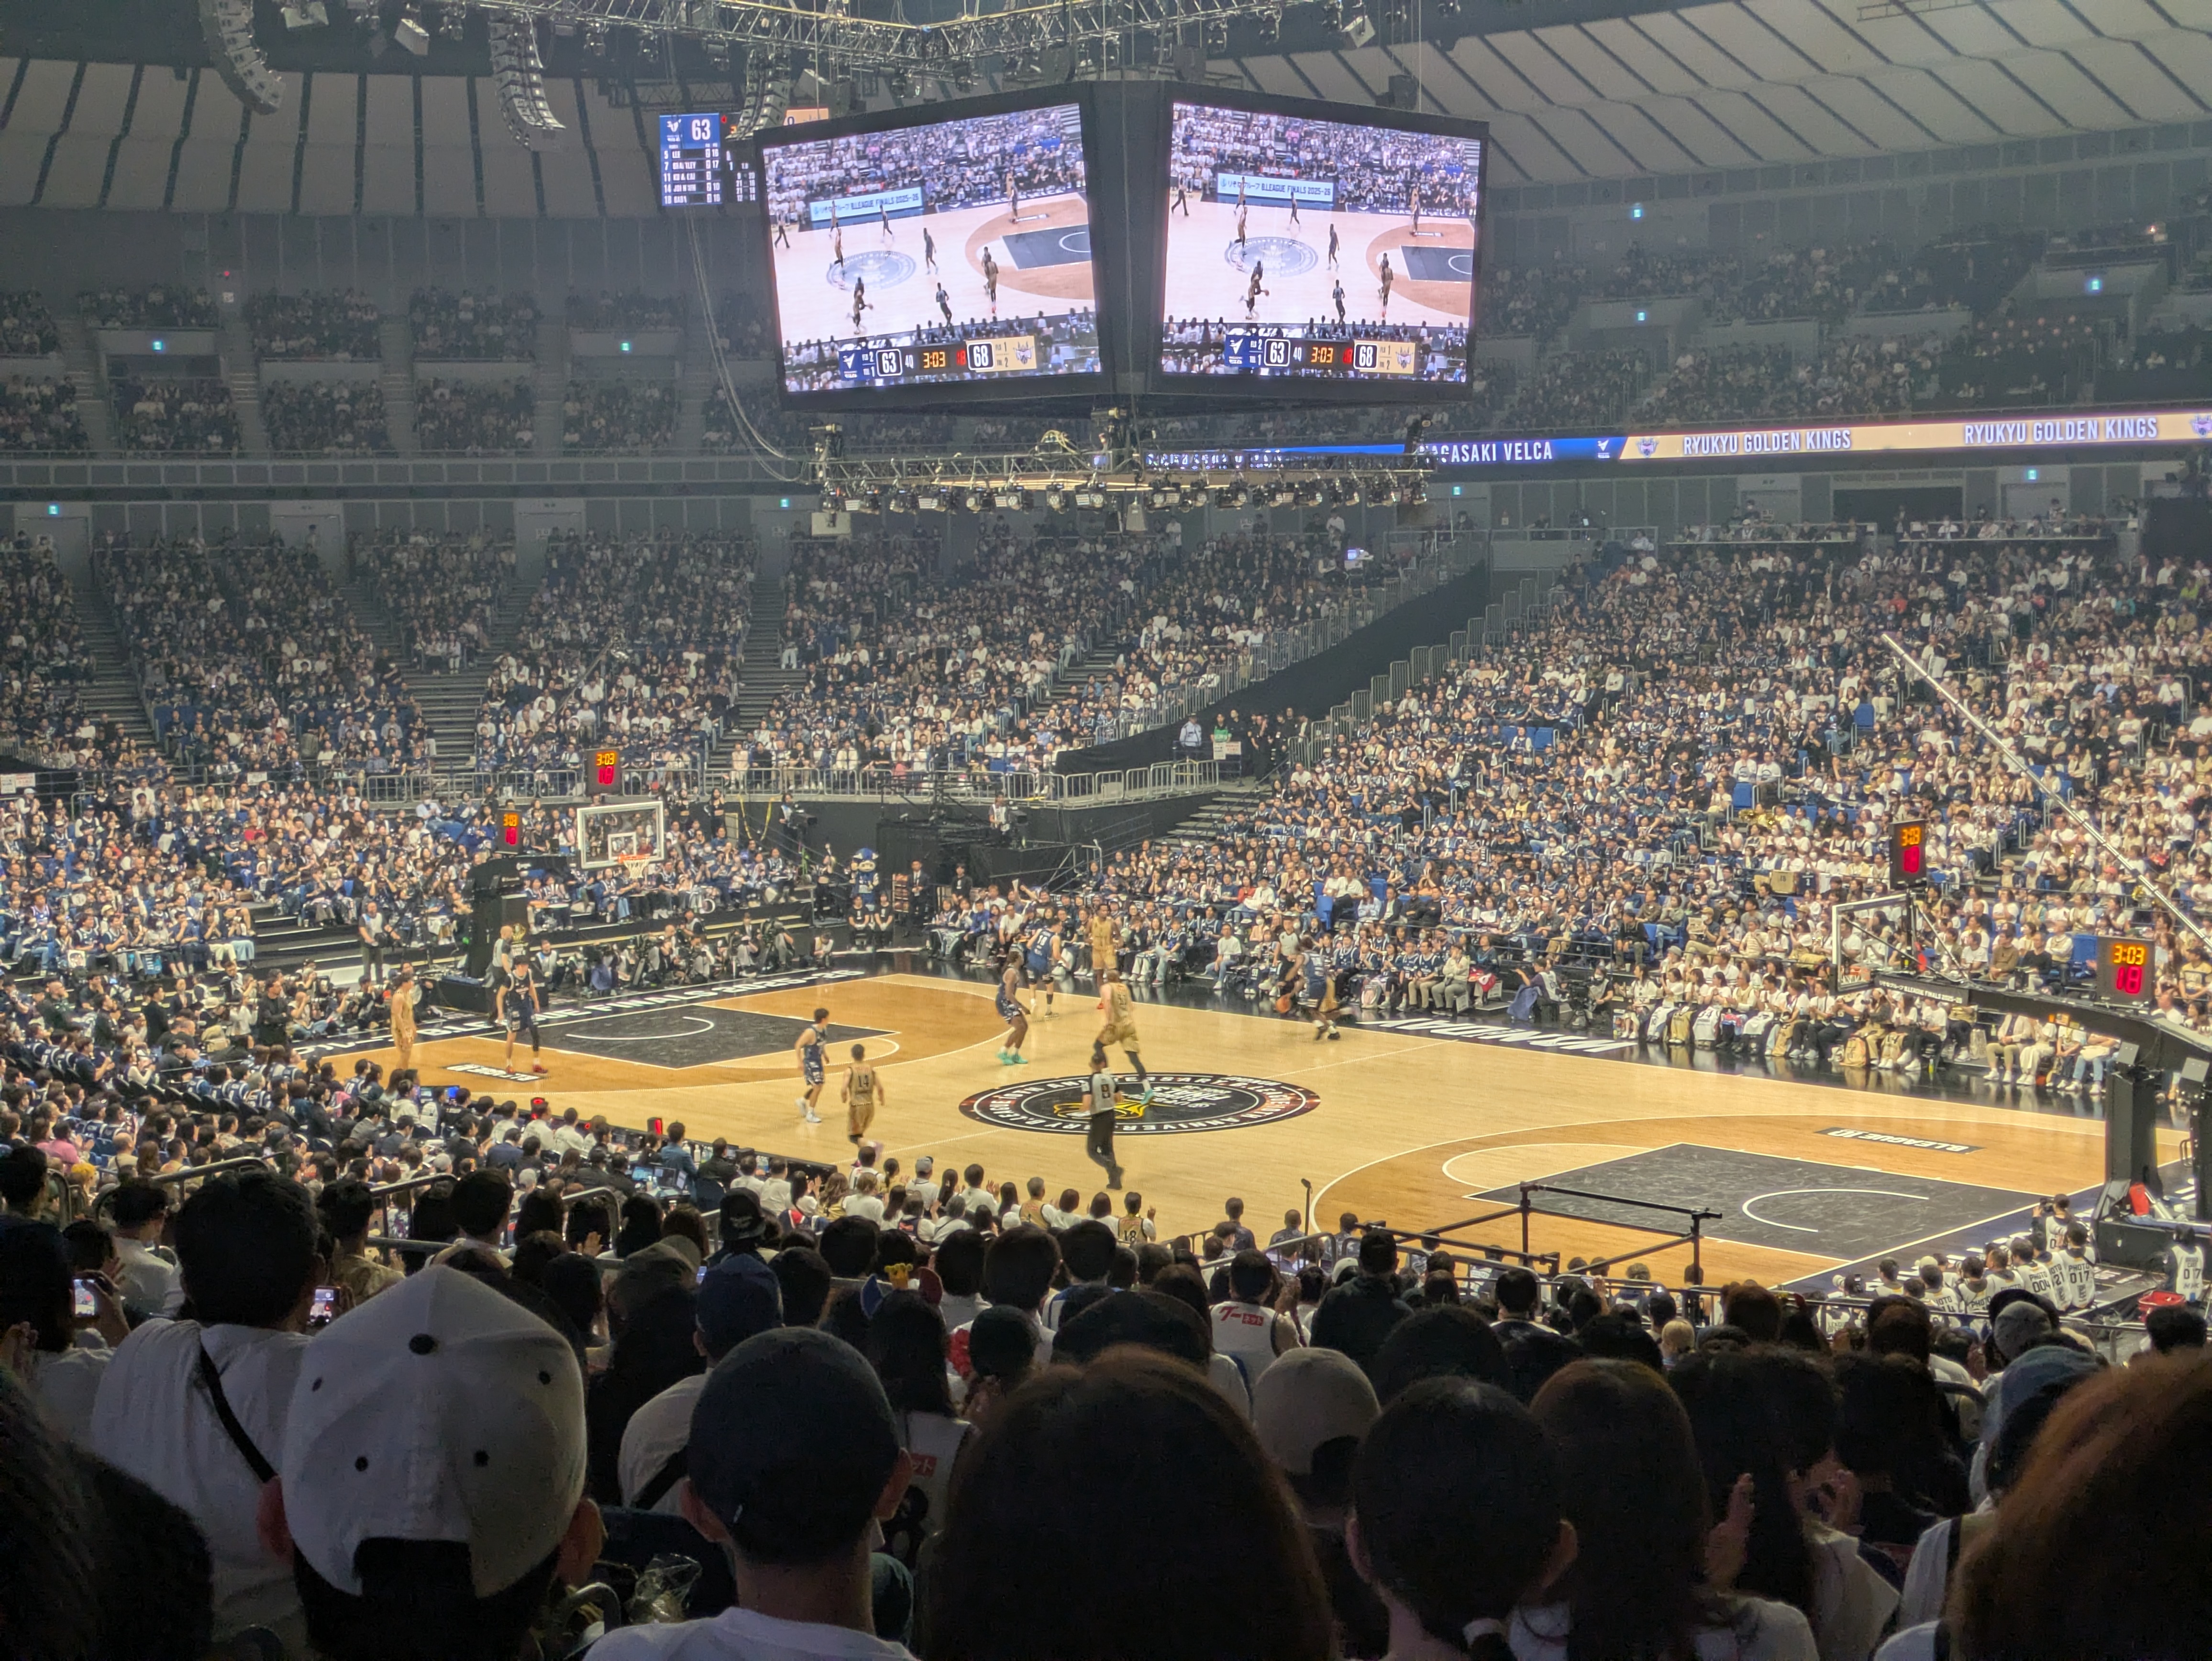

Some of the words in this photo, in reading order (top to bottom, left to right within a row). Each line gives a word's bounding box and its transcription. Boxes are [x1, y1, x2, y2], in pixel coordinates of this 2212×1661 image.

[692, 119, 710, 140] 63
[664, 162, 669, 170] 7
[713, 160, 719, 168] 17
[664, 173, 670, 182] 11
[664, 184, 671, 193] 14
[1258, 339, 1262, 350] 2
[869, 353, 874, 363] 2
[881, 353, 896, 374] 63
[905, 355, 913, 368] 4Q
[923, 352, 946, 369] 3:03
[973, 345, 988, 366] 68
[1270, 342, 1284, 364] 63
[1293, 347, 1302, 362] 4Q
[1310, 346, 1334, 364] 3:03
[1359, 345, 1373, 366] 68
[1005, 357, 1008, 367] 2
[1387, 360, 1391, 370] 2
[1964, 423, 2027, 444] RYUKYU
[2033, 420, 2098, 442] GOLDEN
[2105, 417, 2157, 439] KINGS
[1683, 434, 1738, 455] RYUKYU
[1744, 432, 1800, 453] GOLDEN
[1806, 430, 1851, 450] KINGS
[1503, 441, 1552, 461] VELCA
[597, 752, 615, 766] 3:03
[598, 765, 615, 785] 18
[2113, 944, 2146, 966] 3:03
[2115, 965, 2143, 995] 18
[584, 990, 718, 1012] FINALS
[712, 970, 865, 993] 2025-26
[857, 1074, 870, 1088] 14
[998, 1087, 1045, 1099] 10TH
[1240, 1106, 1285, 1118] 10TH
[1858, 1132, 1969, 1152] B.LEAGUE
[1124, 1230, 1137, 1242] 18
[2068, 1263, 2090, 1272] PHOTO
[2029, 1271, 2048, 1282] PHOTO
[2053, 1273, 2065, 1287] 21
[2070, 1271, 2090, 1284] 017
[2032, 1279, 2050, 1293] 004
[1971, 1296, 1991, 1308] PHOTO
[1219, 1306, 1264, 1327] グーネット
